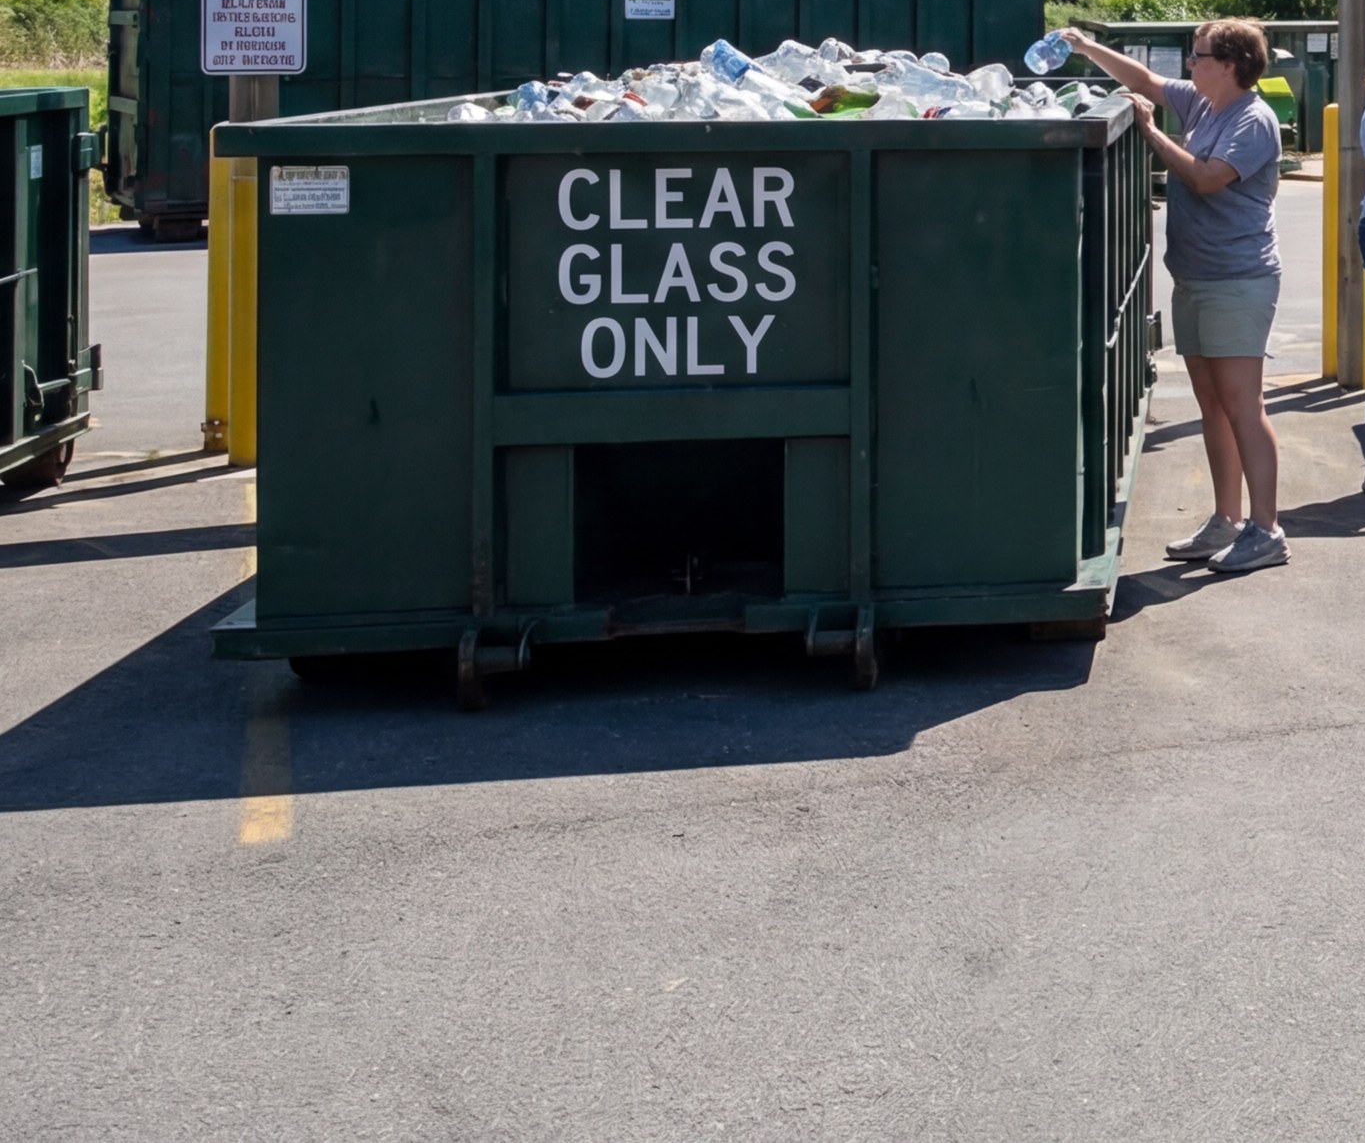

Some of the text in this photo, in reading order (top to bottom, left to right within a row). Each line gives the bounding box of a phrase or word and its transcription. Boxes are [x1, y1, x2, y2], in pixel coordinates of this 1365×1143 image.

[558, 167, 795, 231] CLEAR
[558, 241, 796, 305] GLASS
[581, 314, 776, 379] ONLY
